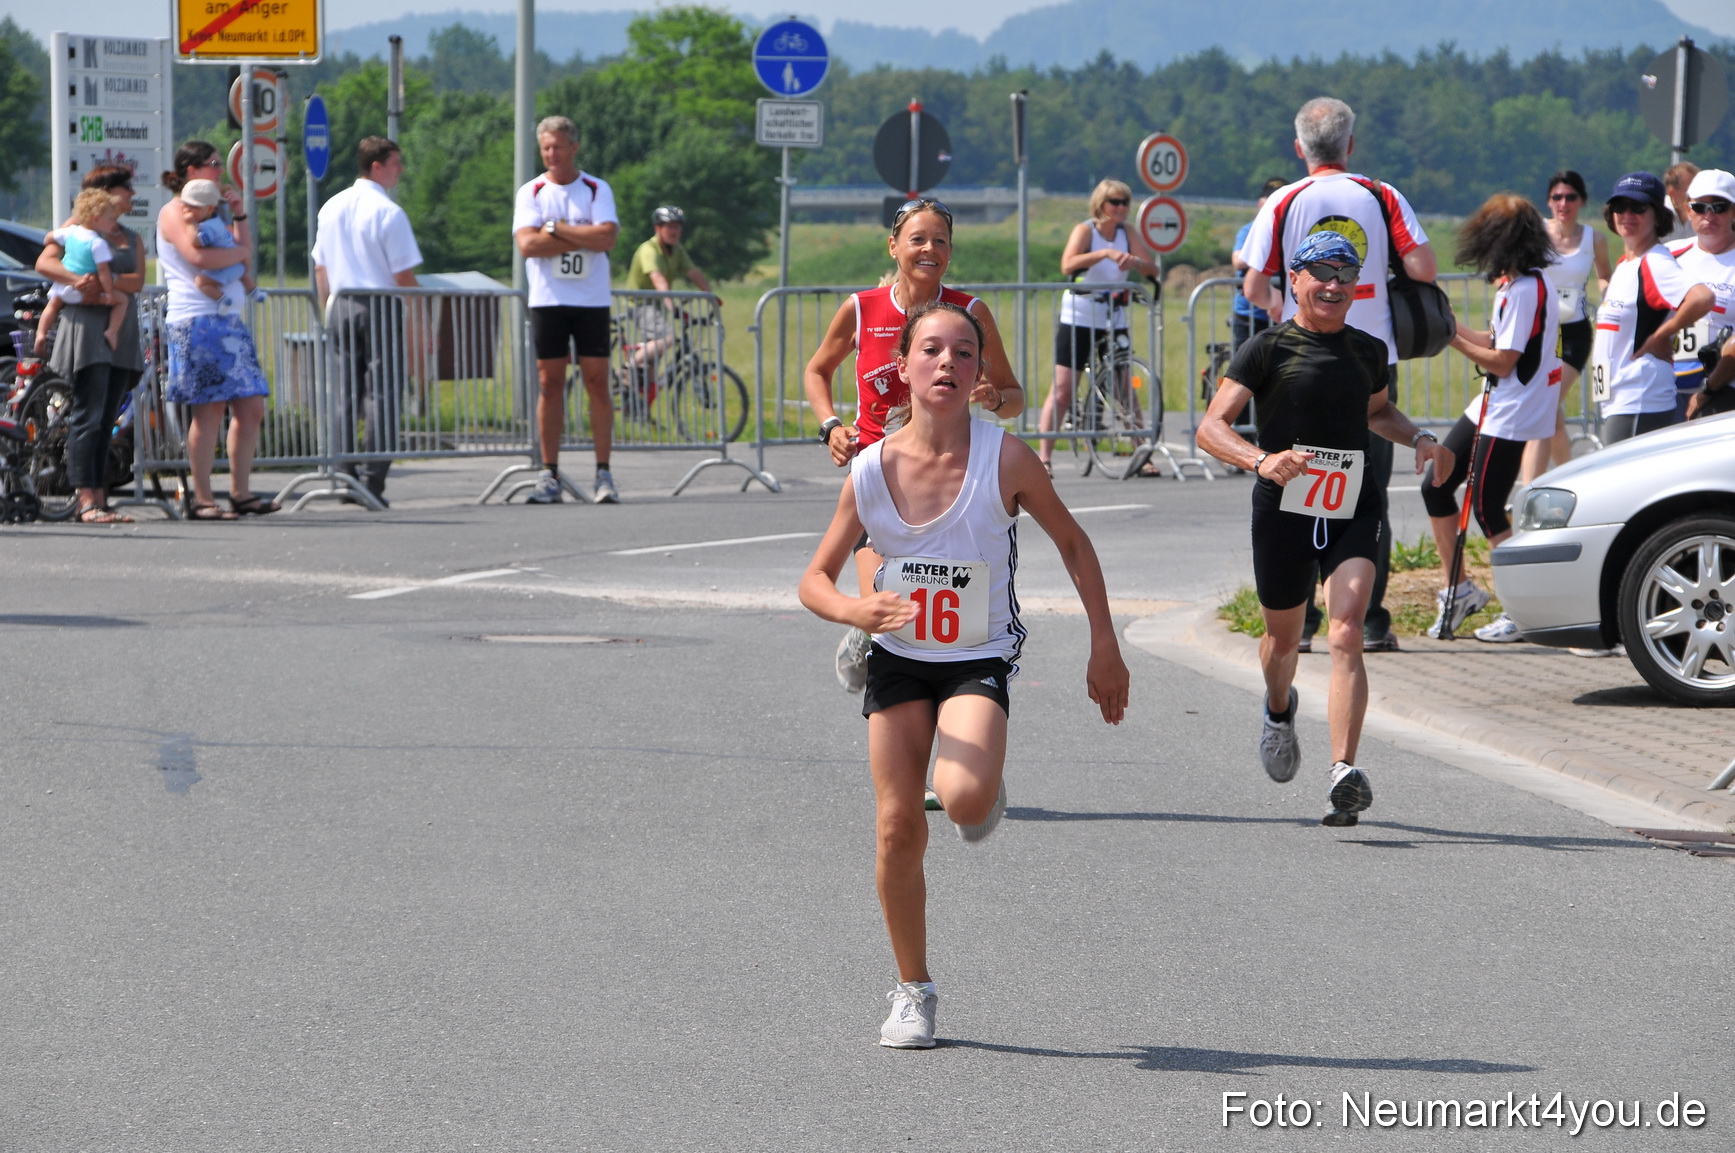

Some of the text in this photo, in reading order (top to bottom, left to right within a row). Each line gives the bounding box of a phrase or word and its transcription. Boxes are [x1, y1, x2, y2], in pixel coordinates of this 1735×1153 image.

[205, 0, 289, 18] am Anger
[218, 30, 268, 42] Neumarkt
[1150, 150, 1178, 177] 60
[560, 252, 583, 275] 50
[1307, 460, 1340, 468] ERBUNG
[1304, 468, 1347, 511] 70
[901, 562, 949, 577] MEYER
[901, 573, 949, 586] WERBUNG
[910, 587, 960, 644] 16
